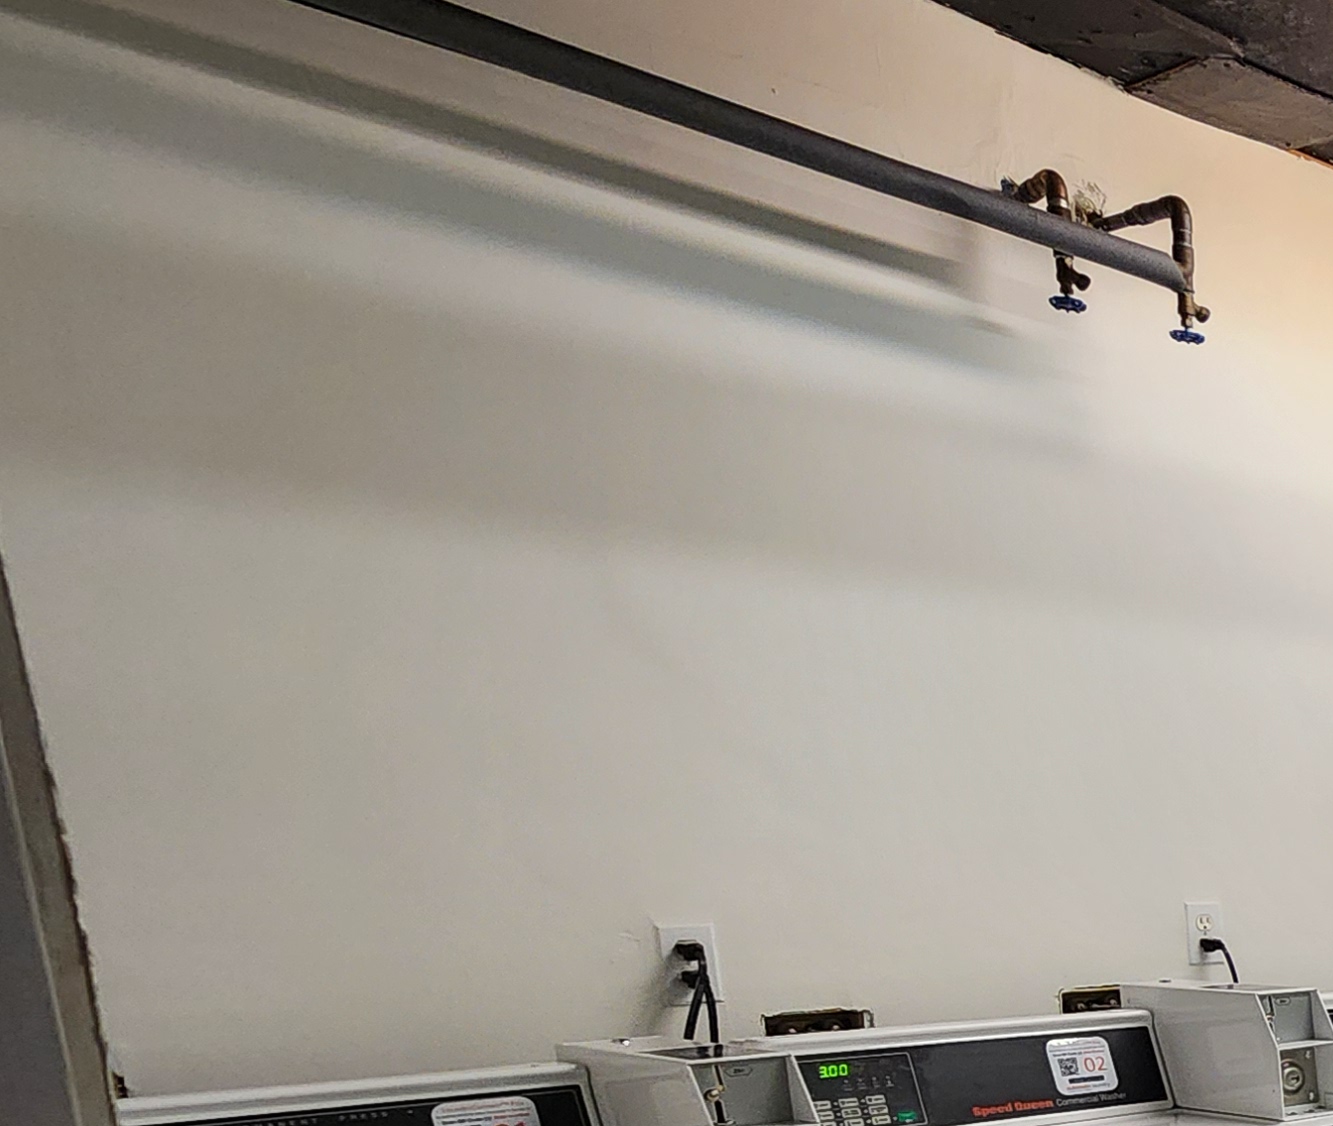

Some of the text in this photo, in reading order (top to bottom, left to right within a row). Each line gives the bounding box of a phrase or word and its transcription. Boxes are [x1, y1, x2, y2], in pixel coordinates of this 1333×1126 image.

[1084, 1056, 1108, 1072] 02
[972, 1103, 1013, 1117] Speed
[1014, 1099, 1054, 1112] Queen
